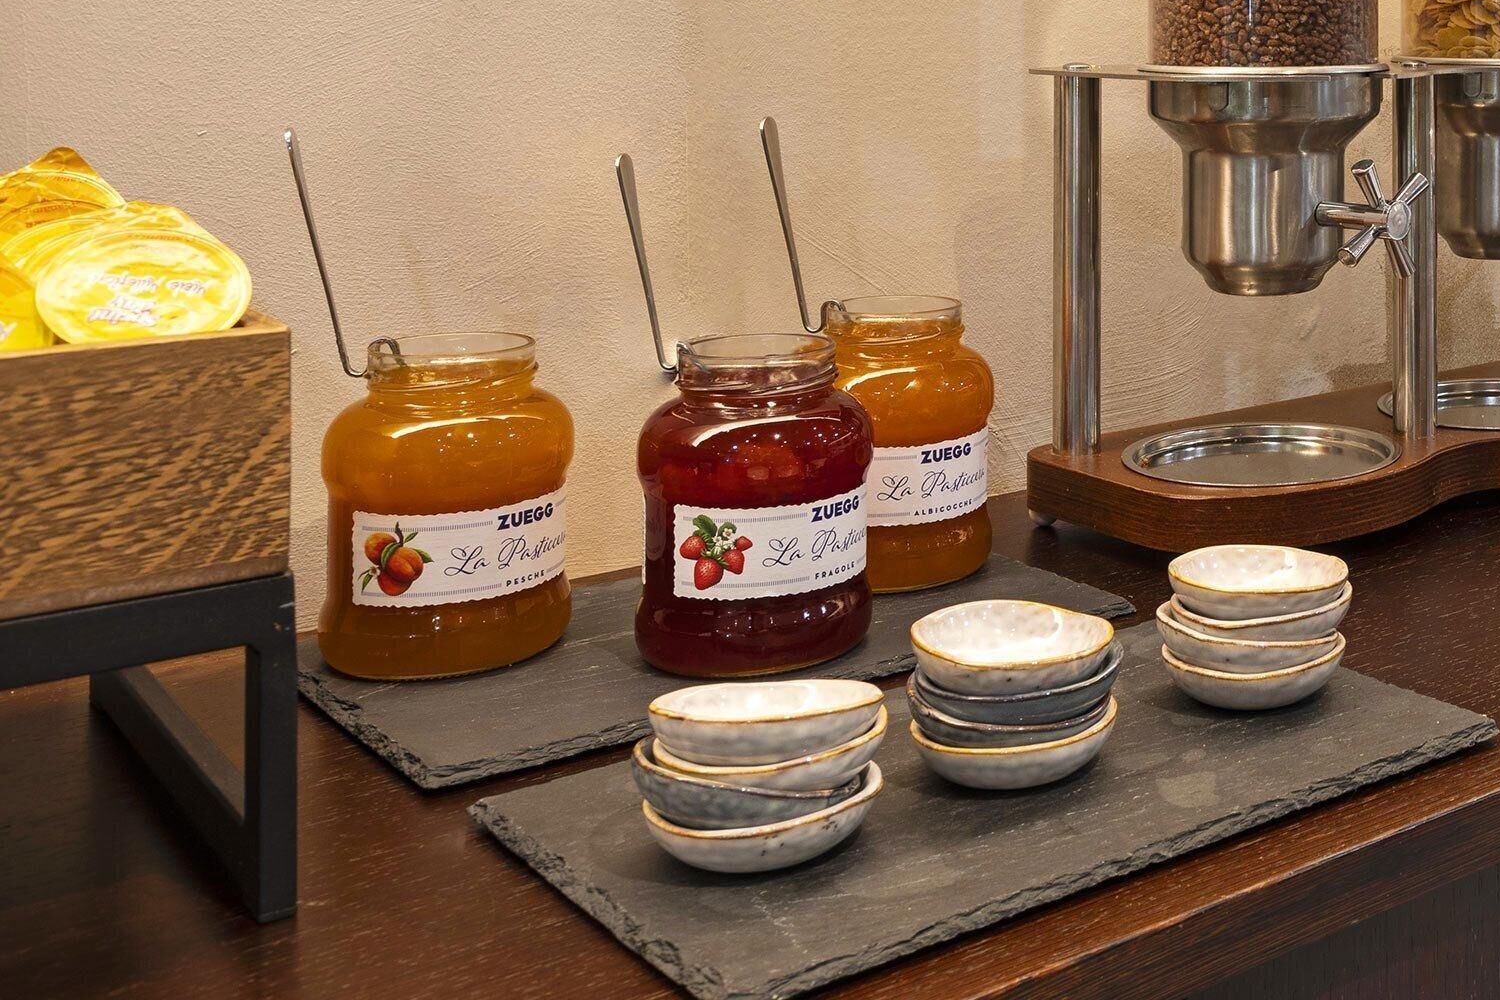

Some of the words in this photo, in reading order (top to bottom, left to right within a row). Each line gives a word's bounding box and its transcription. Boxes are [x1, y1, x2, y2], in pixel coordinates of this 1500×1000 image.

[920, 443, 972, 464] ZUEGG
[876, 476, 915, 501] La
[497, 502, 554, 531] ZUEGG
[811, 495, 860, 523] ZUEGG
[914, 499, 973, 516] ALBICOCCHE
[443, 545, 491, 577] La
[762, 537, 806, 568] La
[506, 570, 545, 588] PESCHE
[814, 561, 855, 580] FRAGOLE
